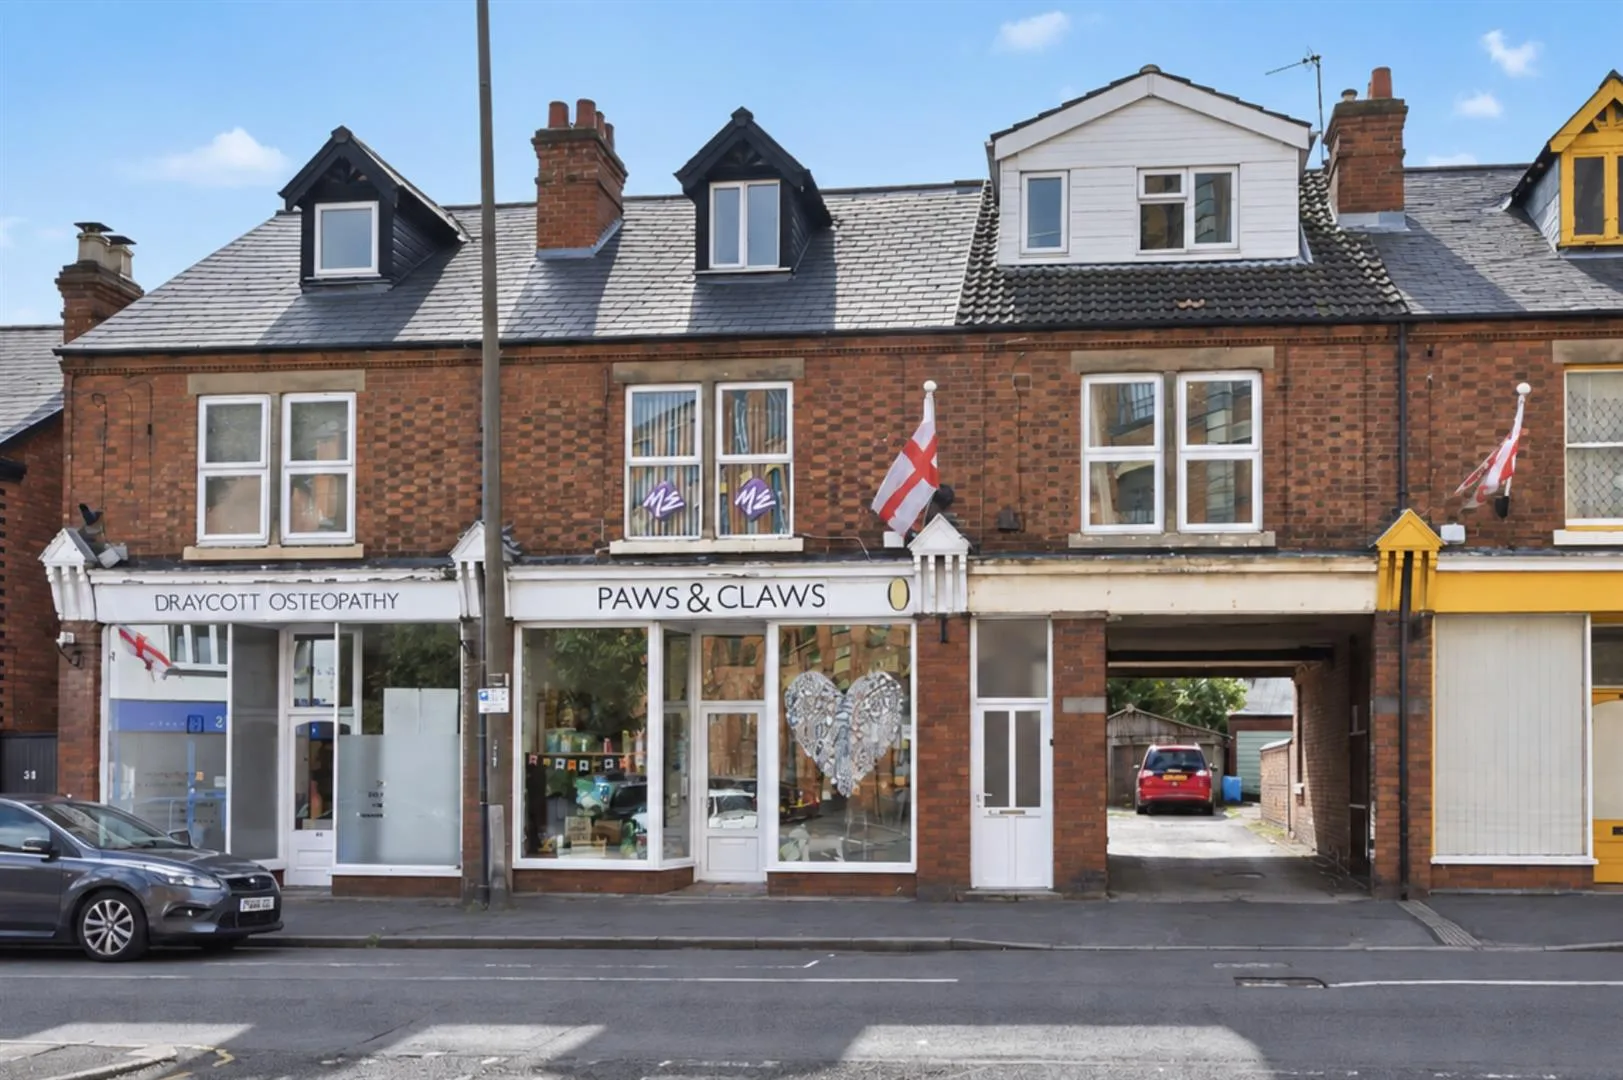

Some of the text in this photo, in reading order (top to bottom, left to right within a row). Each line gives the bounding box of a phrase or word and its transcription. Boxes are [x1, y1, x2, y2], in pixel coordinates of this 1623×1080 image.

[154, 591, 400, 612] DRAYCOTT OSTEOPATHY
[597, 582, 826, 614] PAWS & CLAWS
